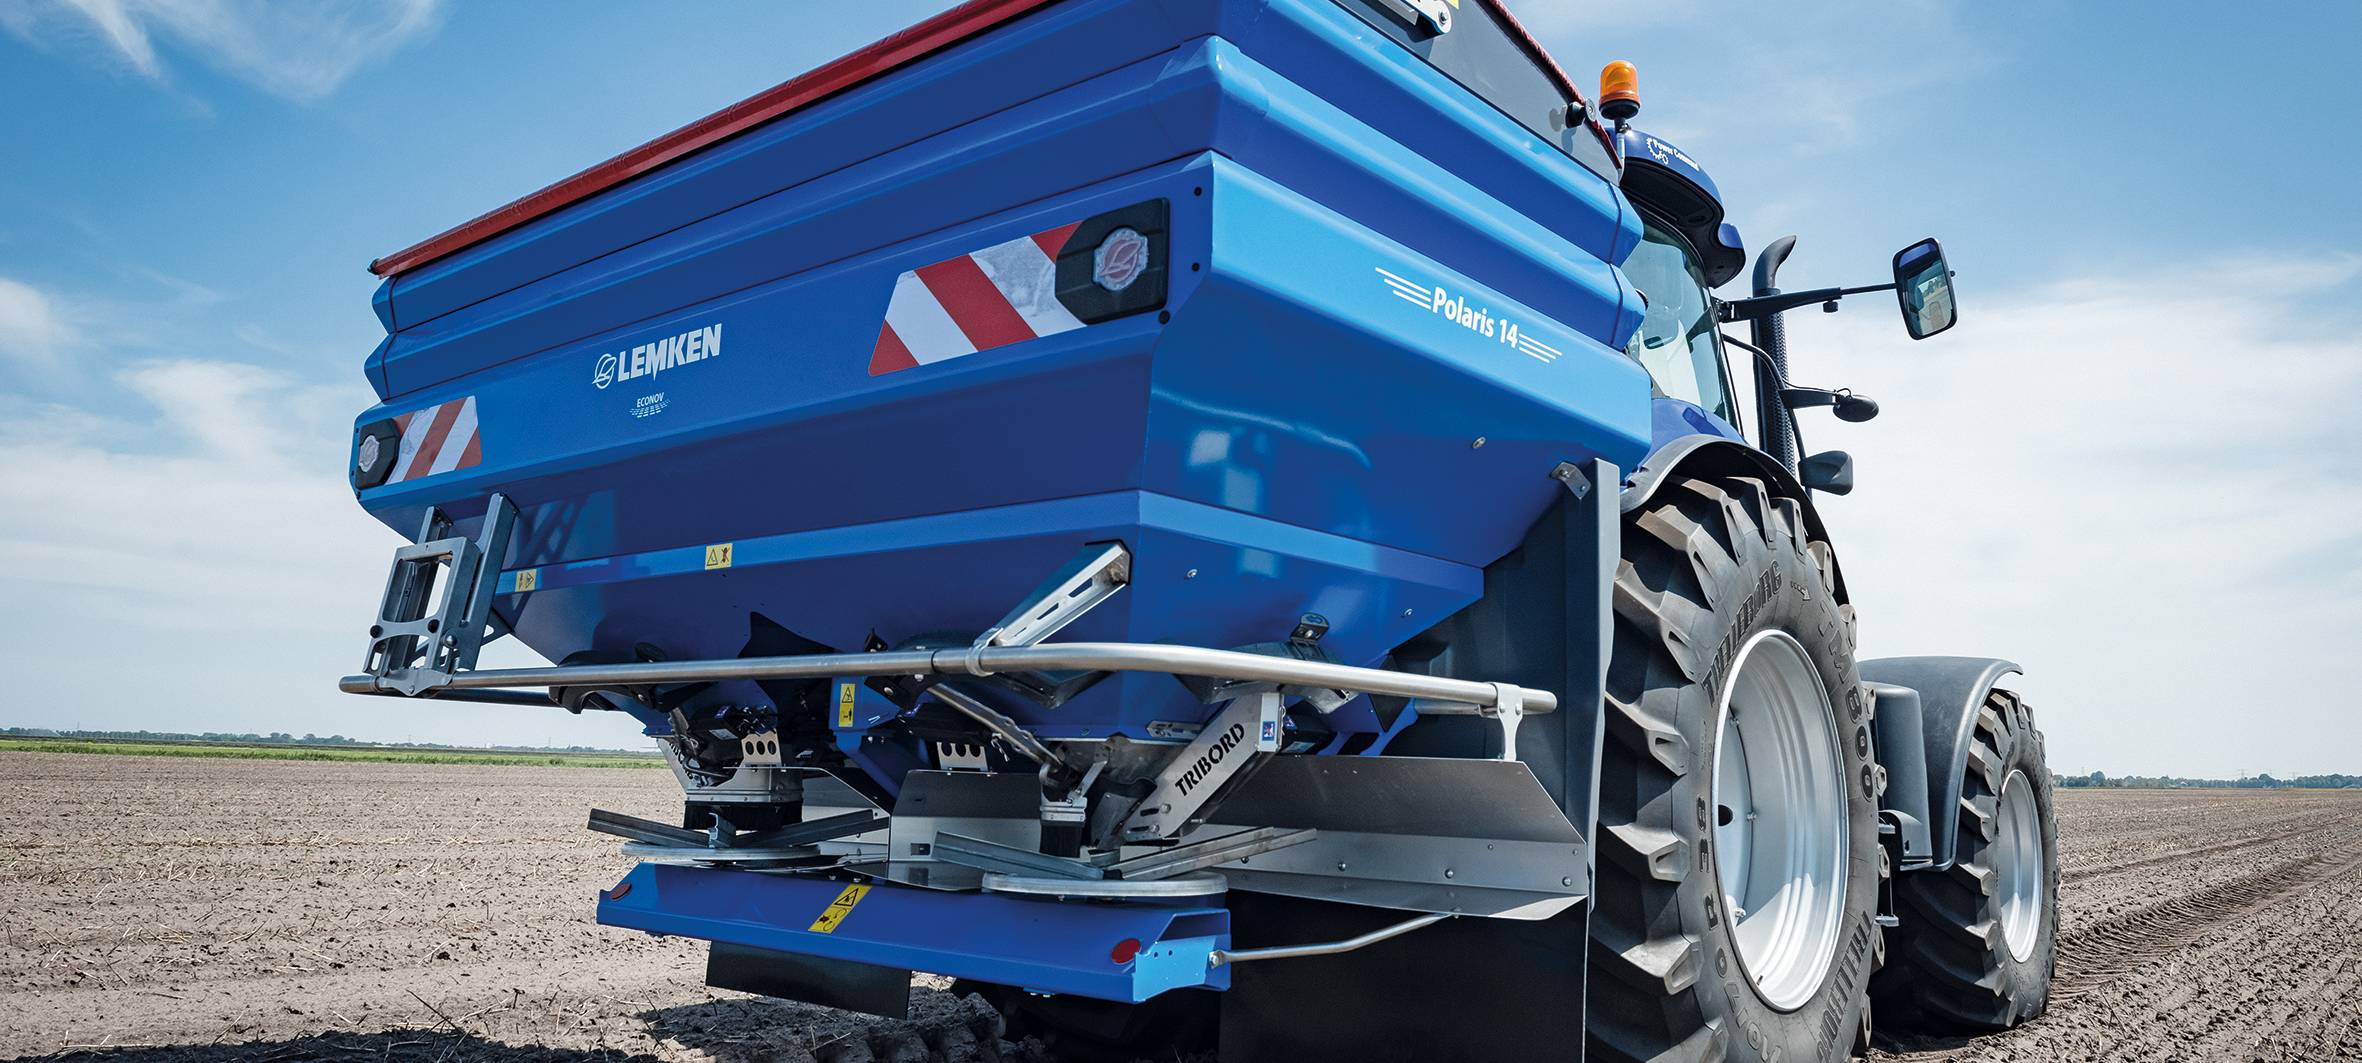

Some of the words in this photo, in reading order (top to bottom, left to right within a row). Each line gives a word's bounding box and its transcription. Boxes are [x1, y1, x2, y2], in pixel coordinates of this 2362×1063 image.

[1432, 286, 1495, 338] Polaris
[1499, 318, 1519, 349] 14
[617, 322, 722, 382] LEMKEN
[636, 391, 665, 408] ECONOV
[1701, 558, 1783, 708] TRELLEBORG
[1174, 722, 1245, 797] TRIBORD
